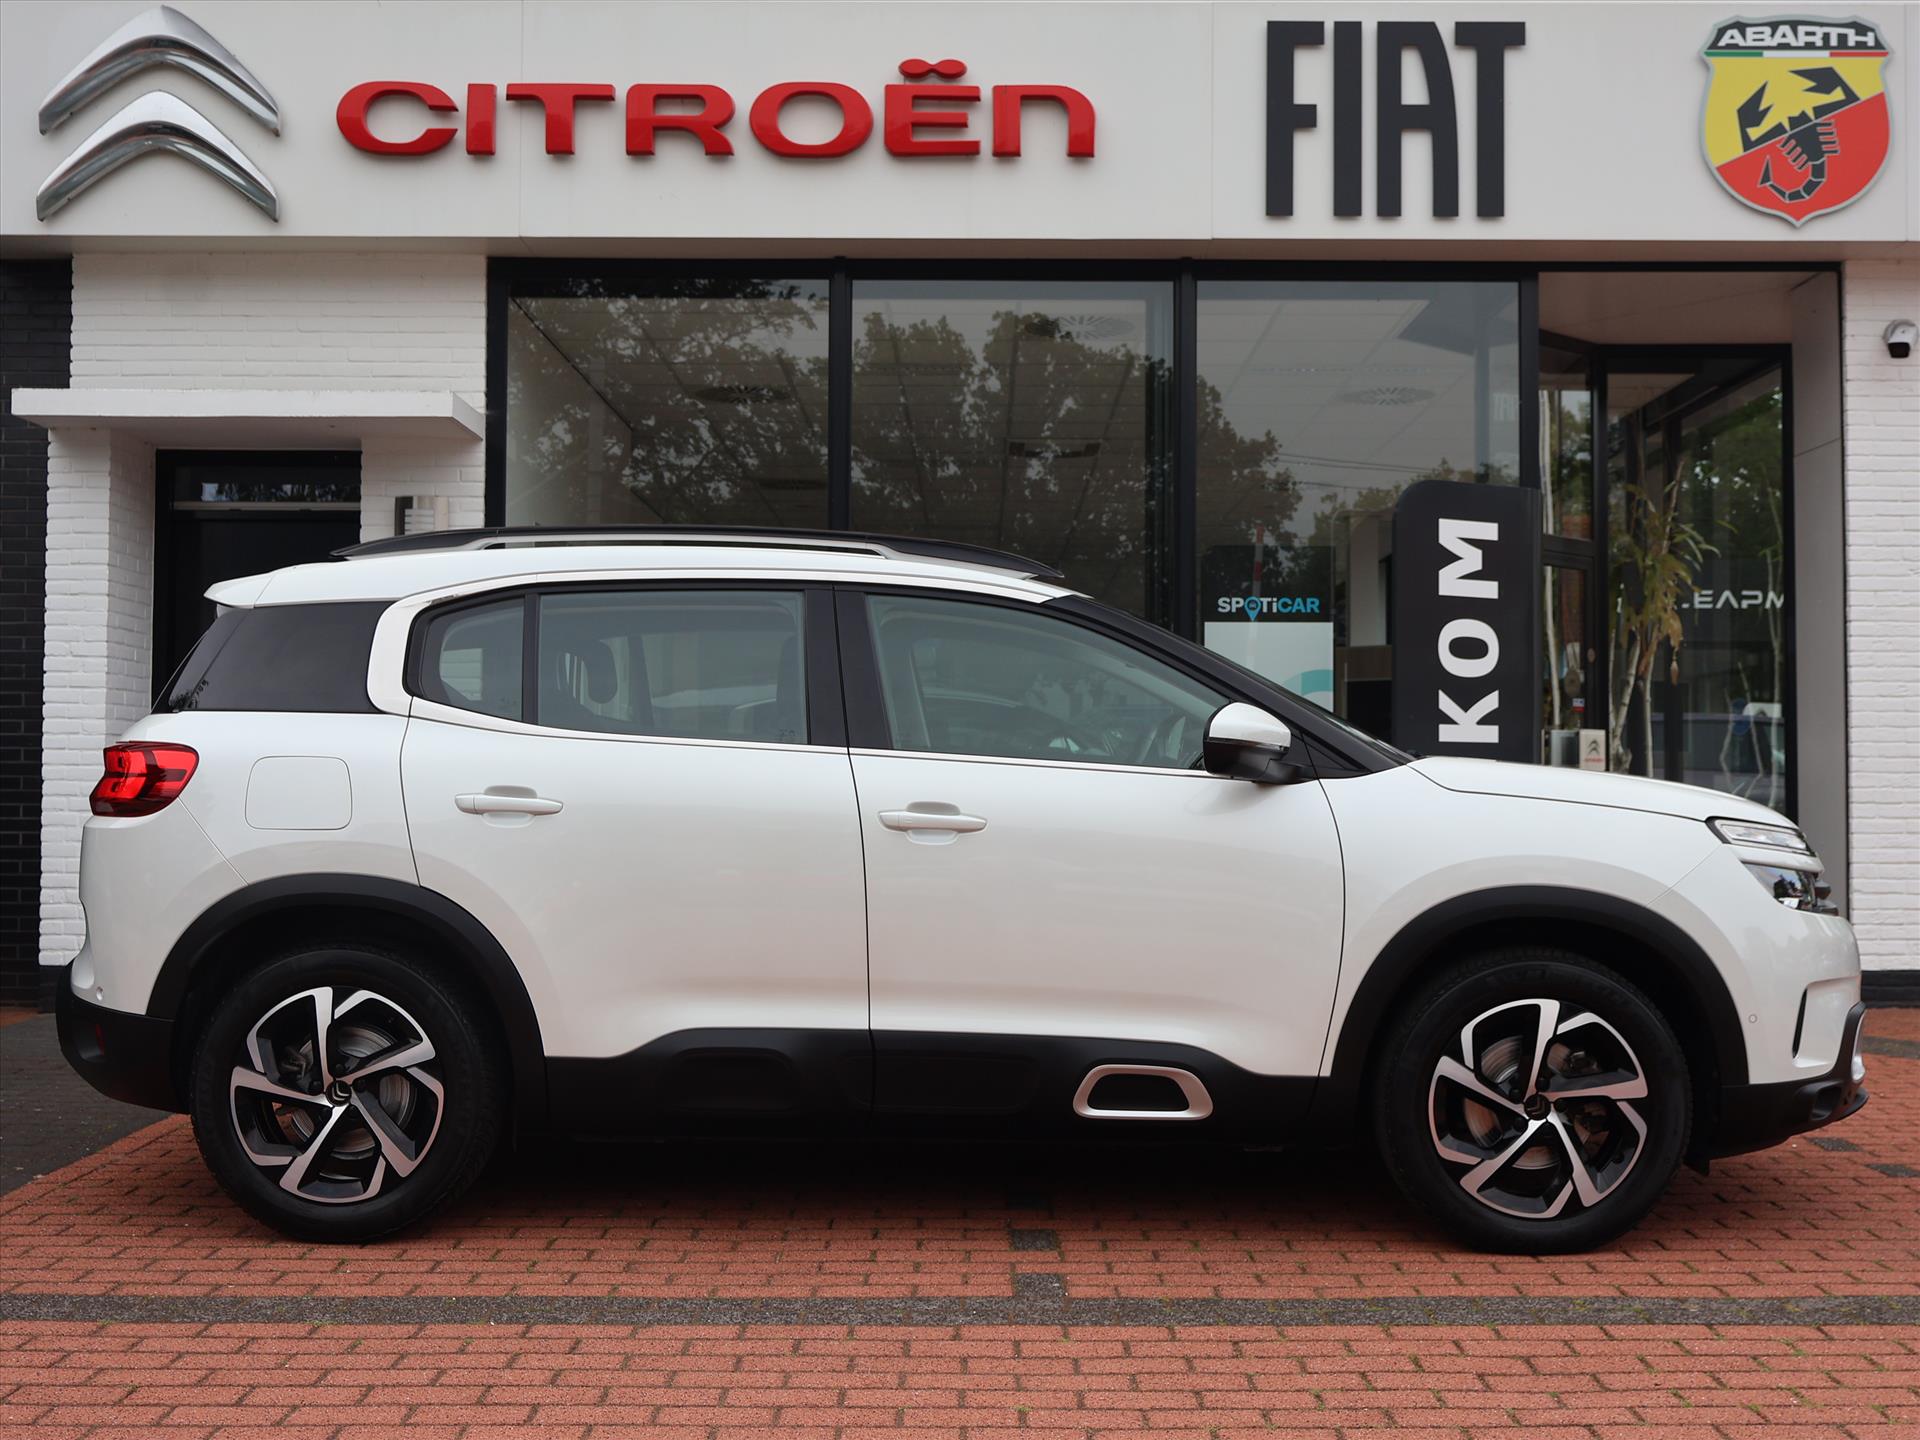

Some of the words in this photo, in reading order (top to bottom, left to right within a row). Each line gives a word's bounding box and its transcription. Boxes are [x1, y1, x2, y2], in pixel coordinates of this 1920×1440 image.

[1266, 21, 1526, 218] FIAT
[1717, 25, 1876, 48] ABARTH
[1437, 517, 1500, 744] KOM
